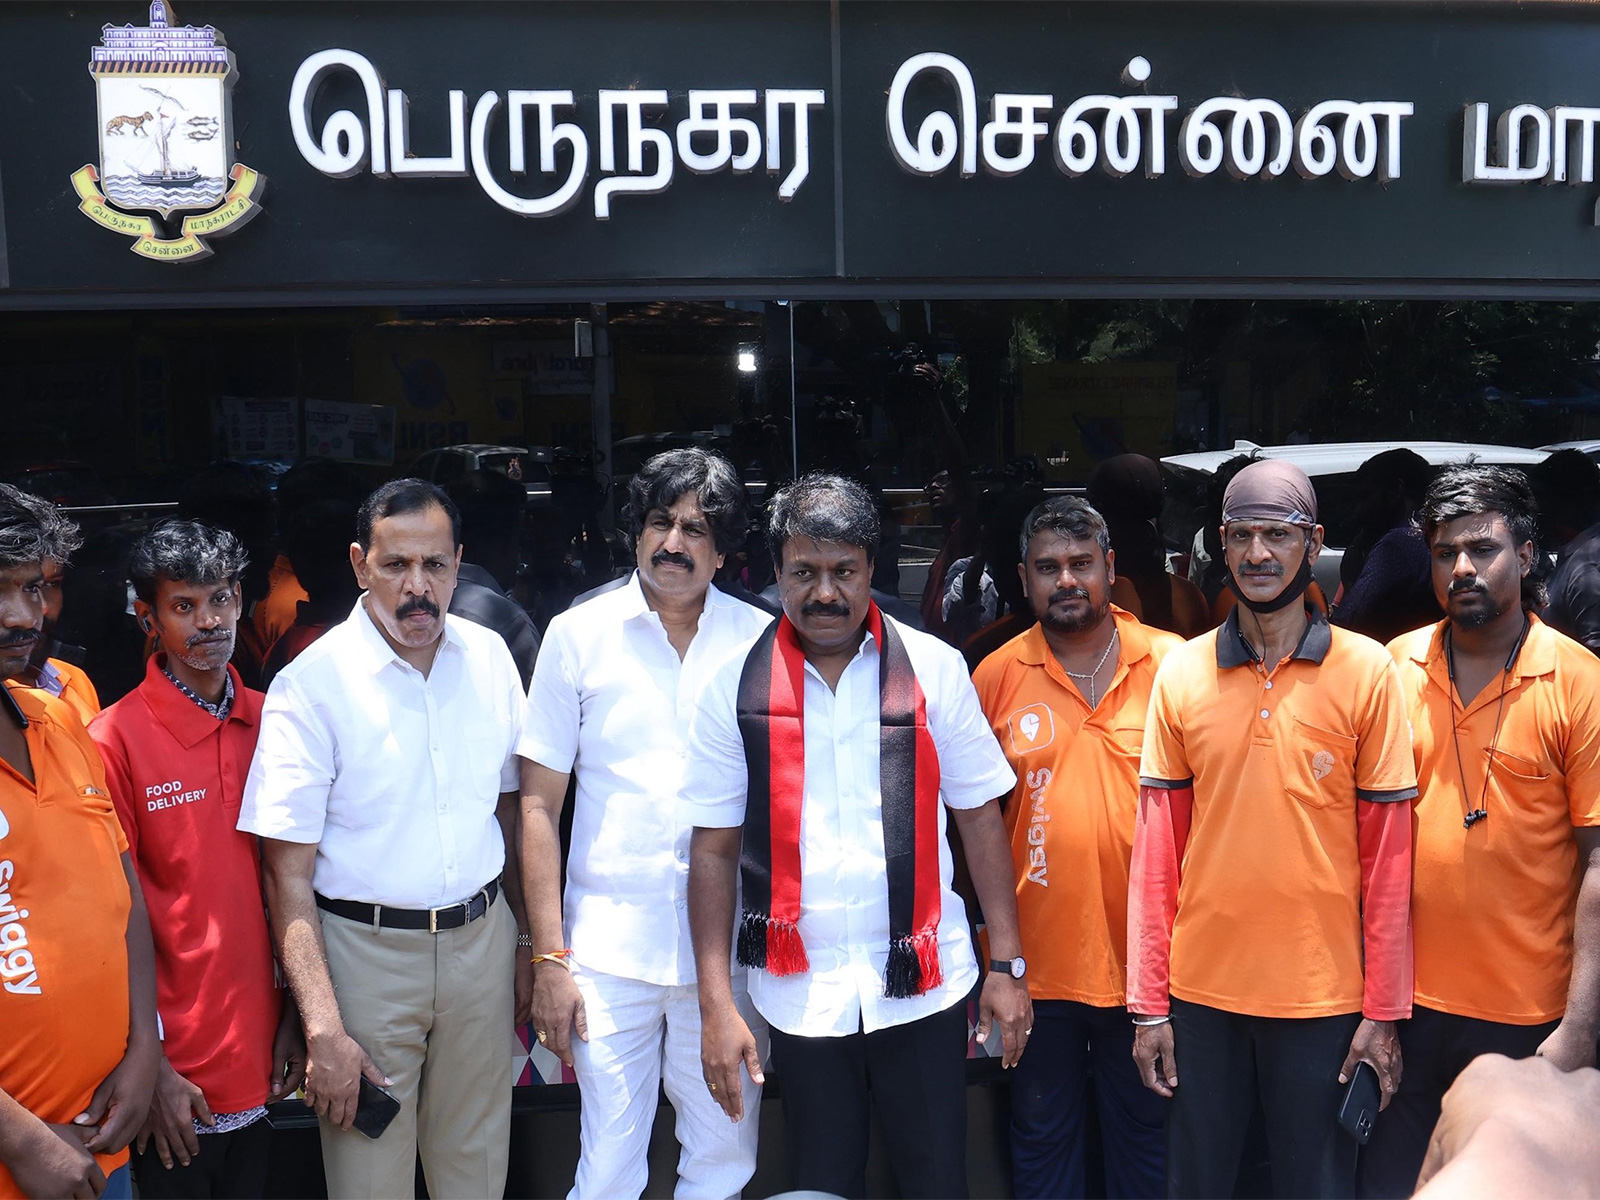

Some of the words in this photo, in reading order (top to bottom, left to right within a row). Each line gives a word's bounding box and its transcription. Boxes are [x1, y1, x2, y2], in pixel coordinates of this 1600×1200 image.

[289, 48, 825, 219] பெருநகர
[887, 52, 1414, 179] சென்னை
[1468, 101, 1600, 212] மா
[91, 205, 142, 231] பெருநகர
[142, 240, 195, 256] சென்னை
[145, 780, 182, 798] FOOD
[147, 788, 207, 812] DELIVERY
[1026, 767, 1052, 887] Swiggy
